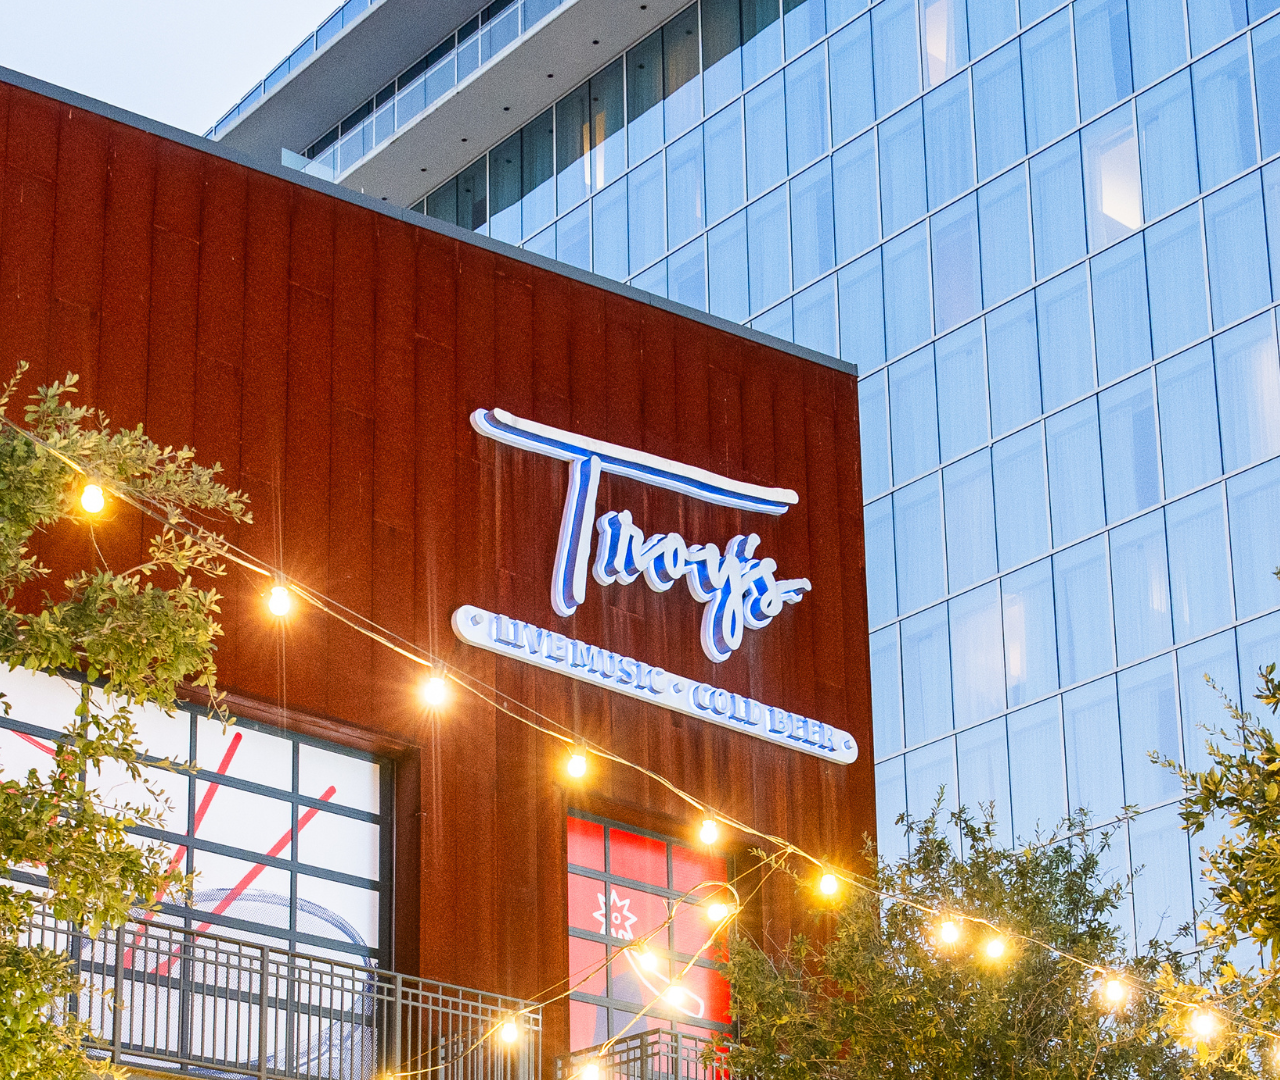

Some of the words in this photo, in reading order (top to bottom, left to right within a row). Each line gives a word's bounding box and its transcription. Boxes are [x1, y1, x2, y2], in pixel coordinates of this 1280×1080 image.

[495, 613, 567, 662] LIVE
[570, 639, 667, 694] MUSIC
[693, 683, 764, 726] COLD
[769, 706, 837, 752] BEER
